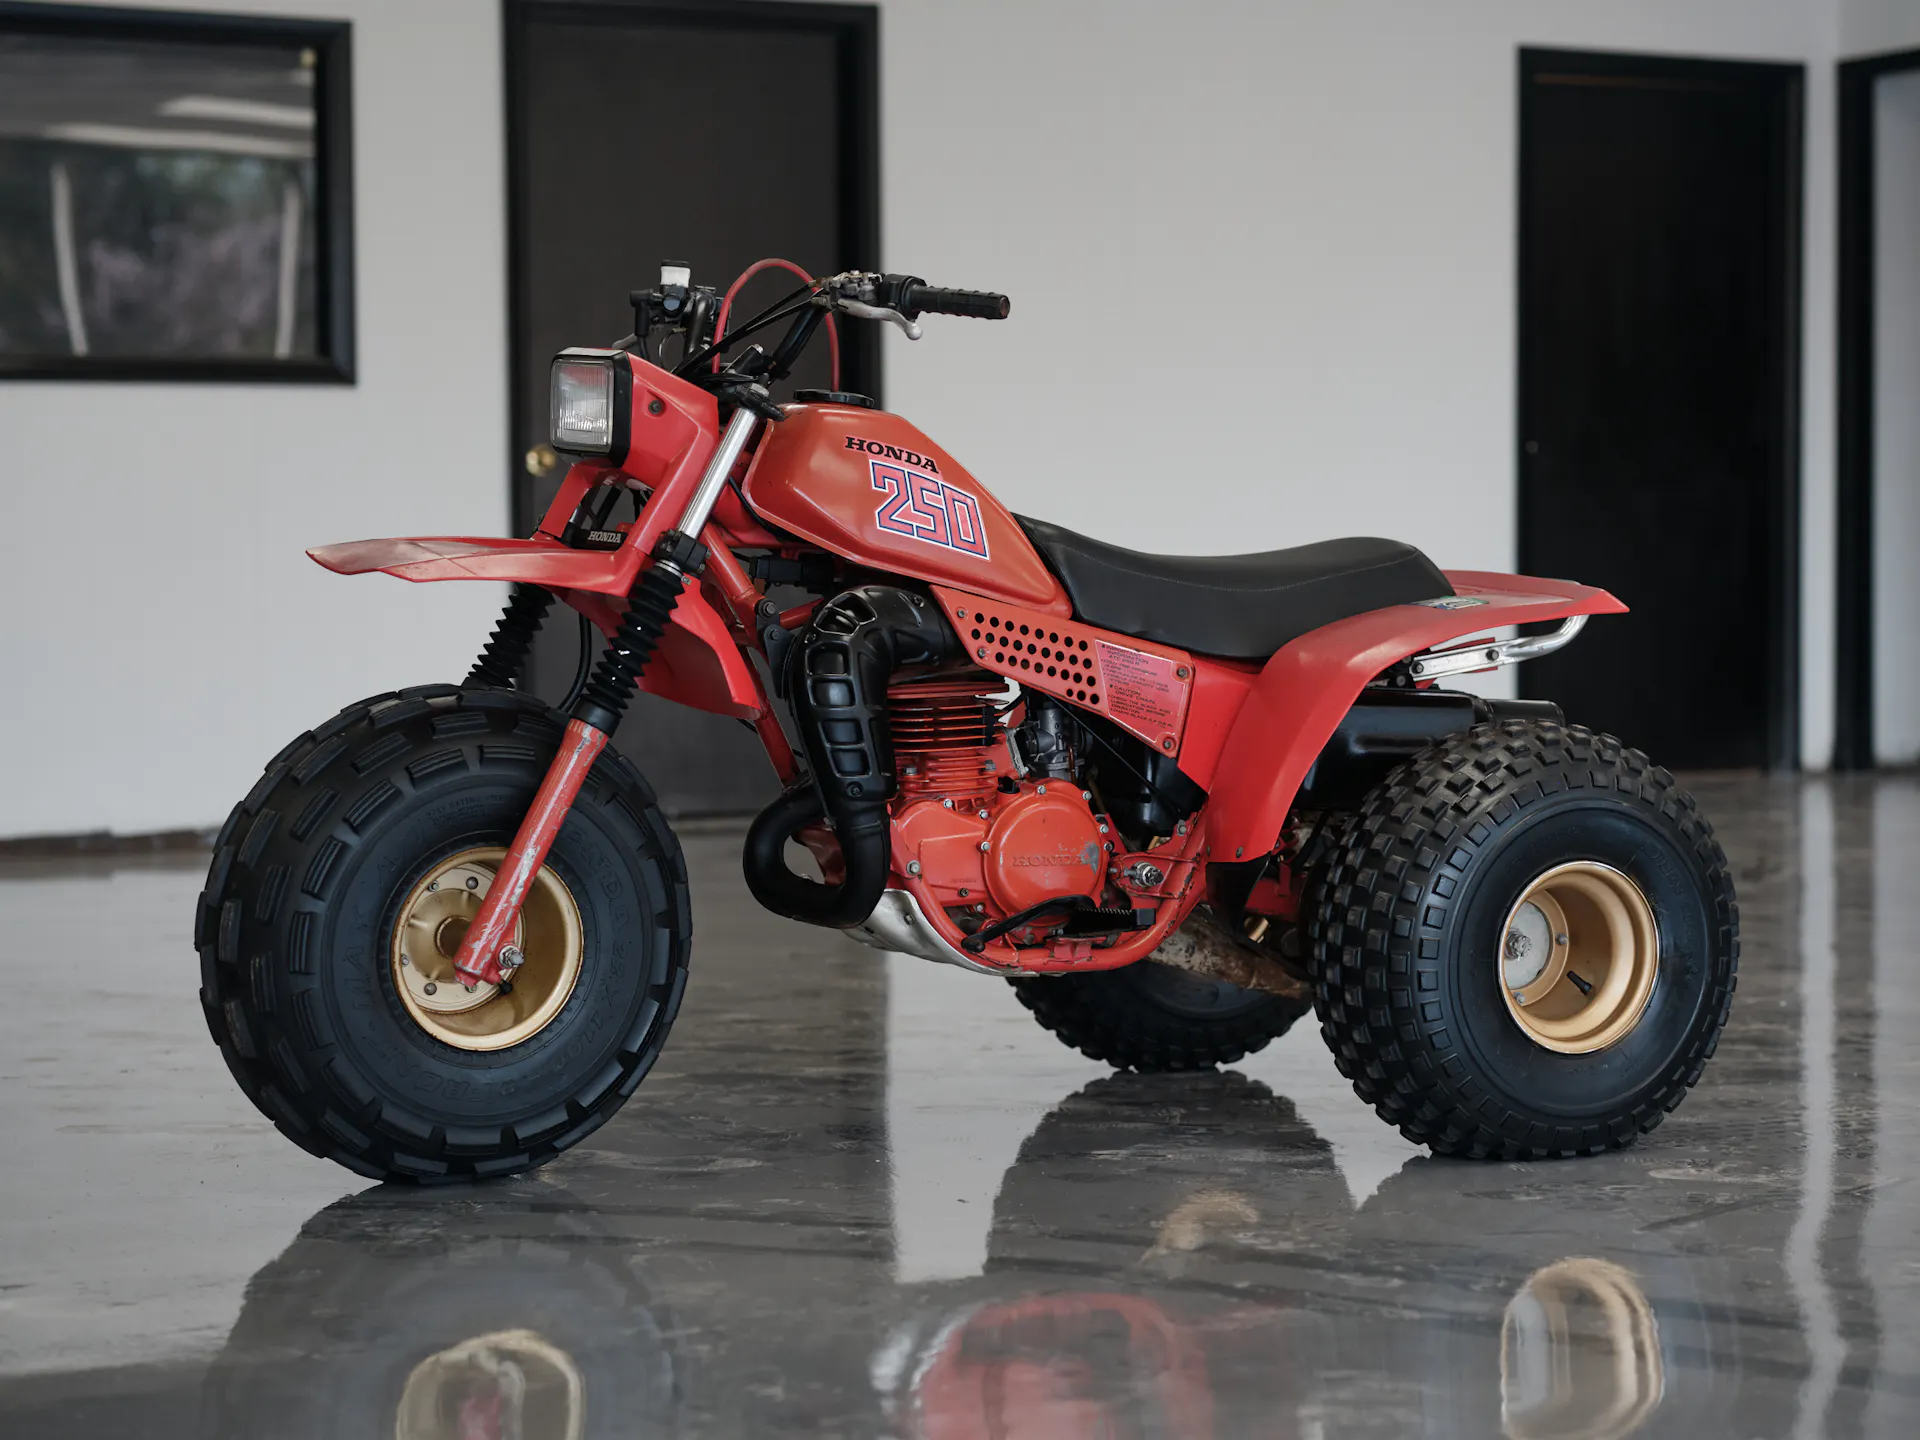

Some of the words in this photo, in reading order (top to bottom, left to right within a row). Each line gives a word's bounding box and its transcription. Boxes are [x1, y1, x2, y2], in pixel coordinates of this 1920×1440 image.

[845, 436, 940, 475] HONDA
[869, 459, 991, 561] 250
[588, 530, 622, 543] HONDA
[1013, 854, 1089, 867] HONDA
